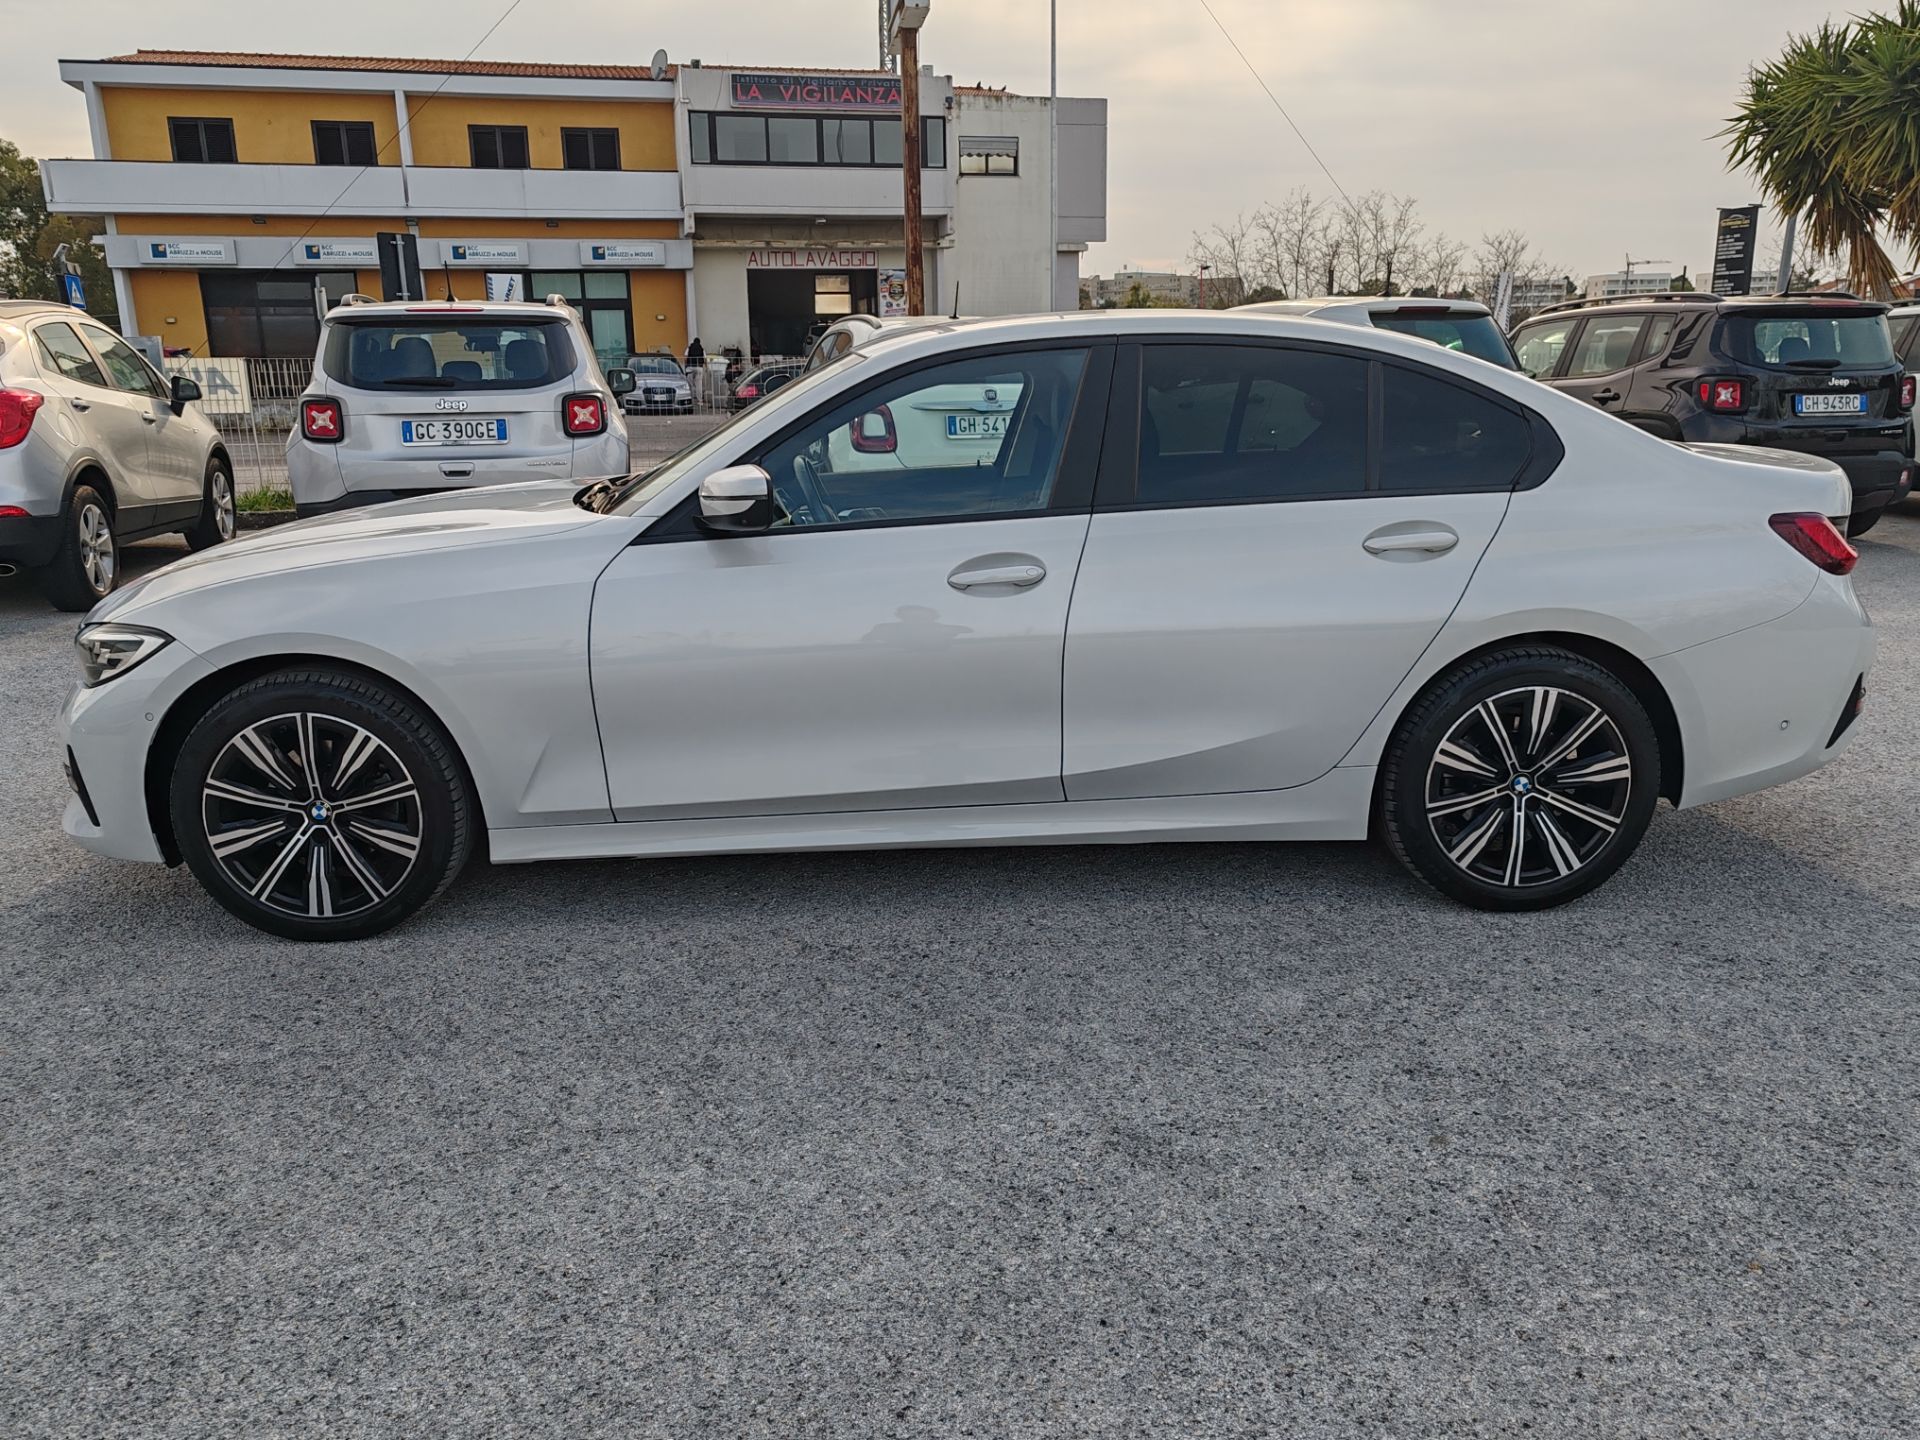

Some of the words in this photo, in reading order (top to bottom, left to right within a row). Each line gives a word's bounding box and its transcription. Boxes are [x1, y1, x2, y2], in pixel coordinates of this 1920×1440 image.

[736, 75, 777, 84] Istituto
[782, 76, 794, 85] di
[800, 77, 856, 87] Vigilanza
[736, 83, 763, 100] LA
[780, 85, 901, 104] VIGILANZA
[748, 251, 876, 267] AUTOLAVAGGIO
[1828, 377, 1850, 387] Jeep
[436, 399, 468, 411] Jeep
